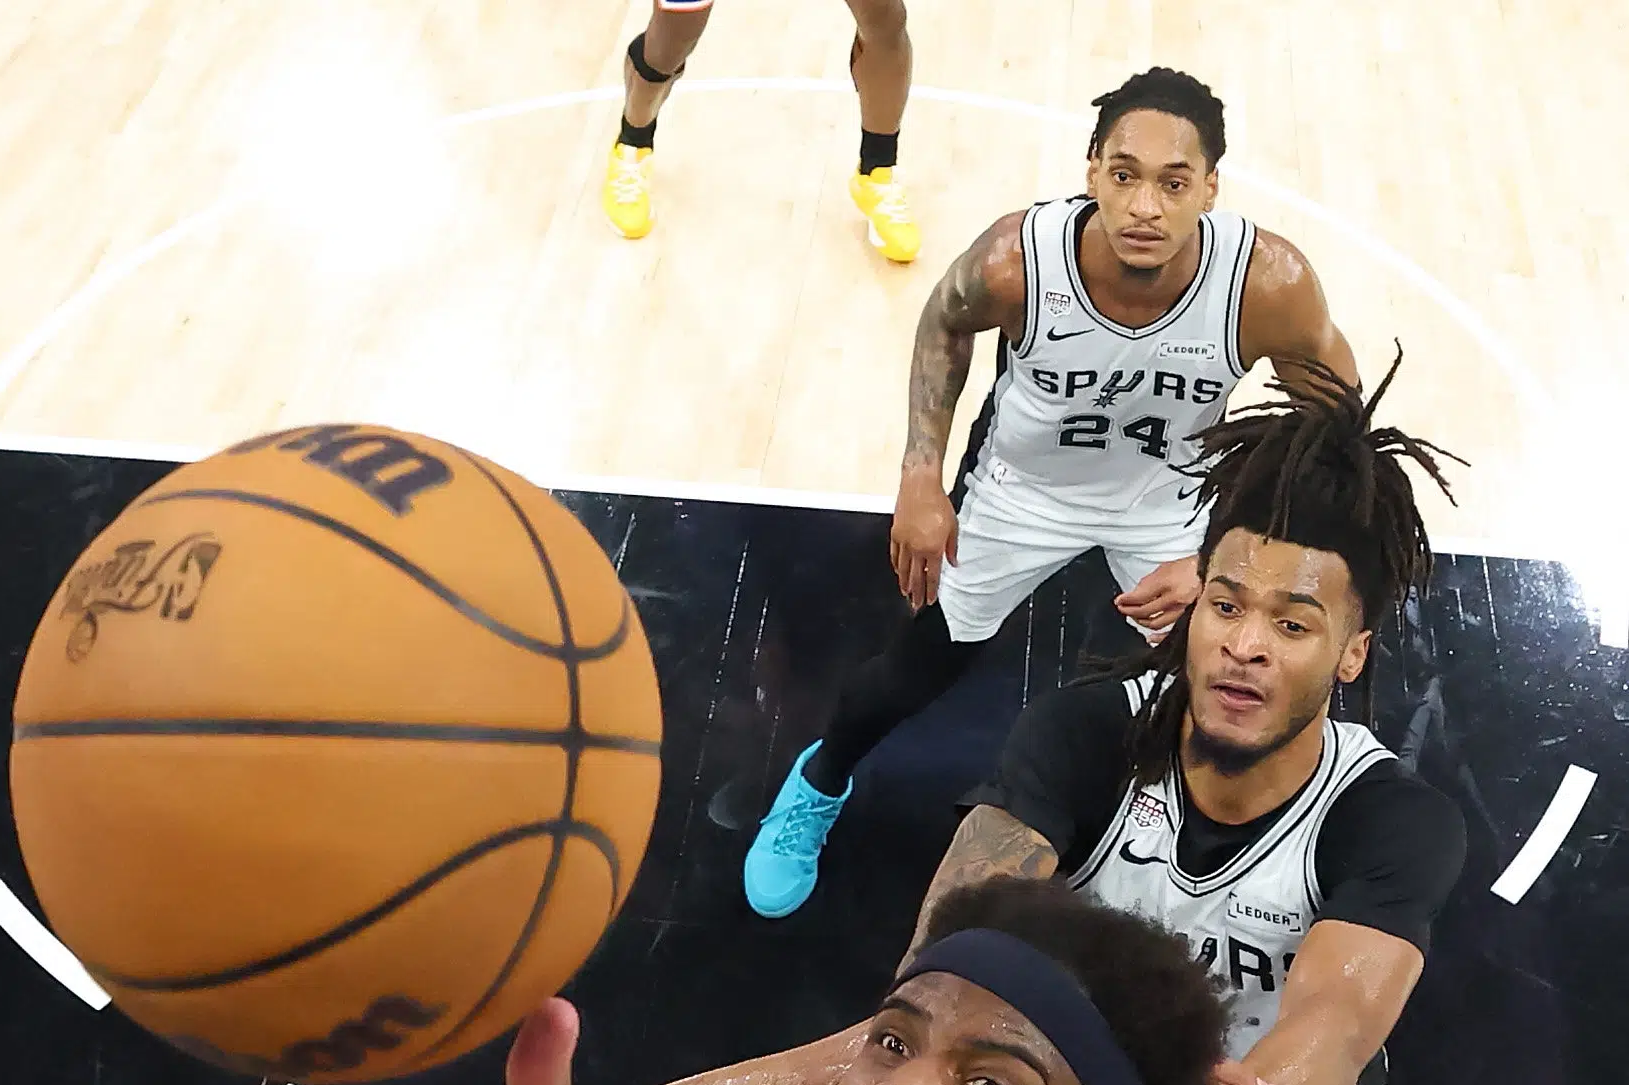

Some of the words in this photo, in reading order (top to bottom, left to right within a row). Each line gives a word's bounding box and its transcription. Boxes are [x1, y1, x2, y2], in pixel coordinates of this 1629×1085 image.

[1167, 346, 1208, 355] LEDGER
[1032, 368, 1223, 408] SPURS
[1057, 413, 1170, 461] 24
[1137, 794, 1164, 813] USA
[1236, 903, 1290, 926] LEDGER
